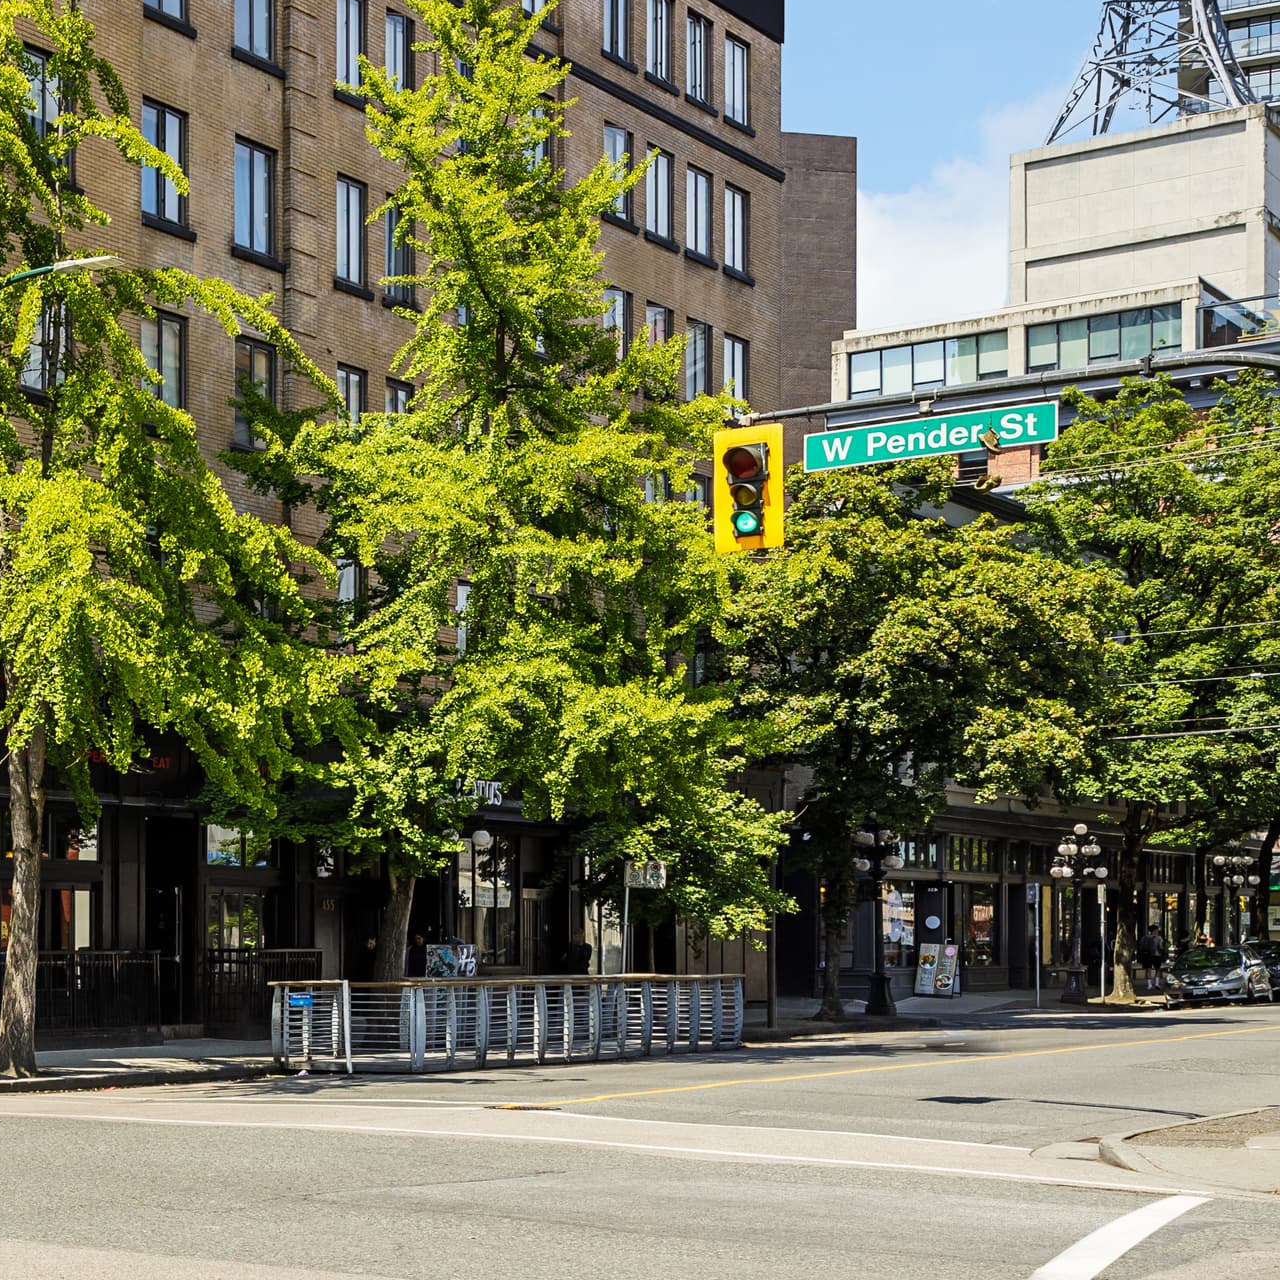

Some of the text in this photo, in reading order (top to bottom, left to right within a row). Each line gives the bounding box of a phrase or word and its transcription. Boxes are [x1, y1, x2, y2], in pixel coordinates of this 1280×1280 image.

[821, 412, 1038, 463] W Pender St
[152, 756, 171, 769] EAT
